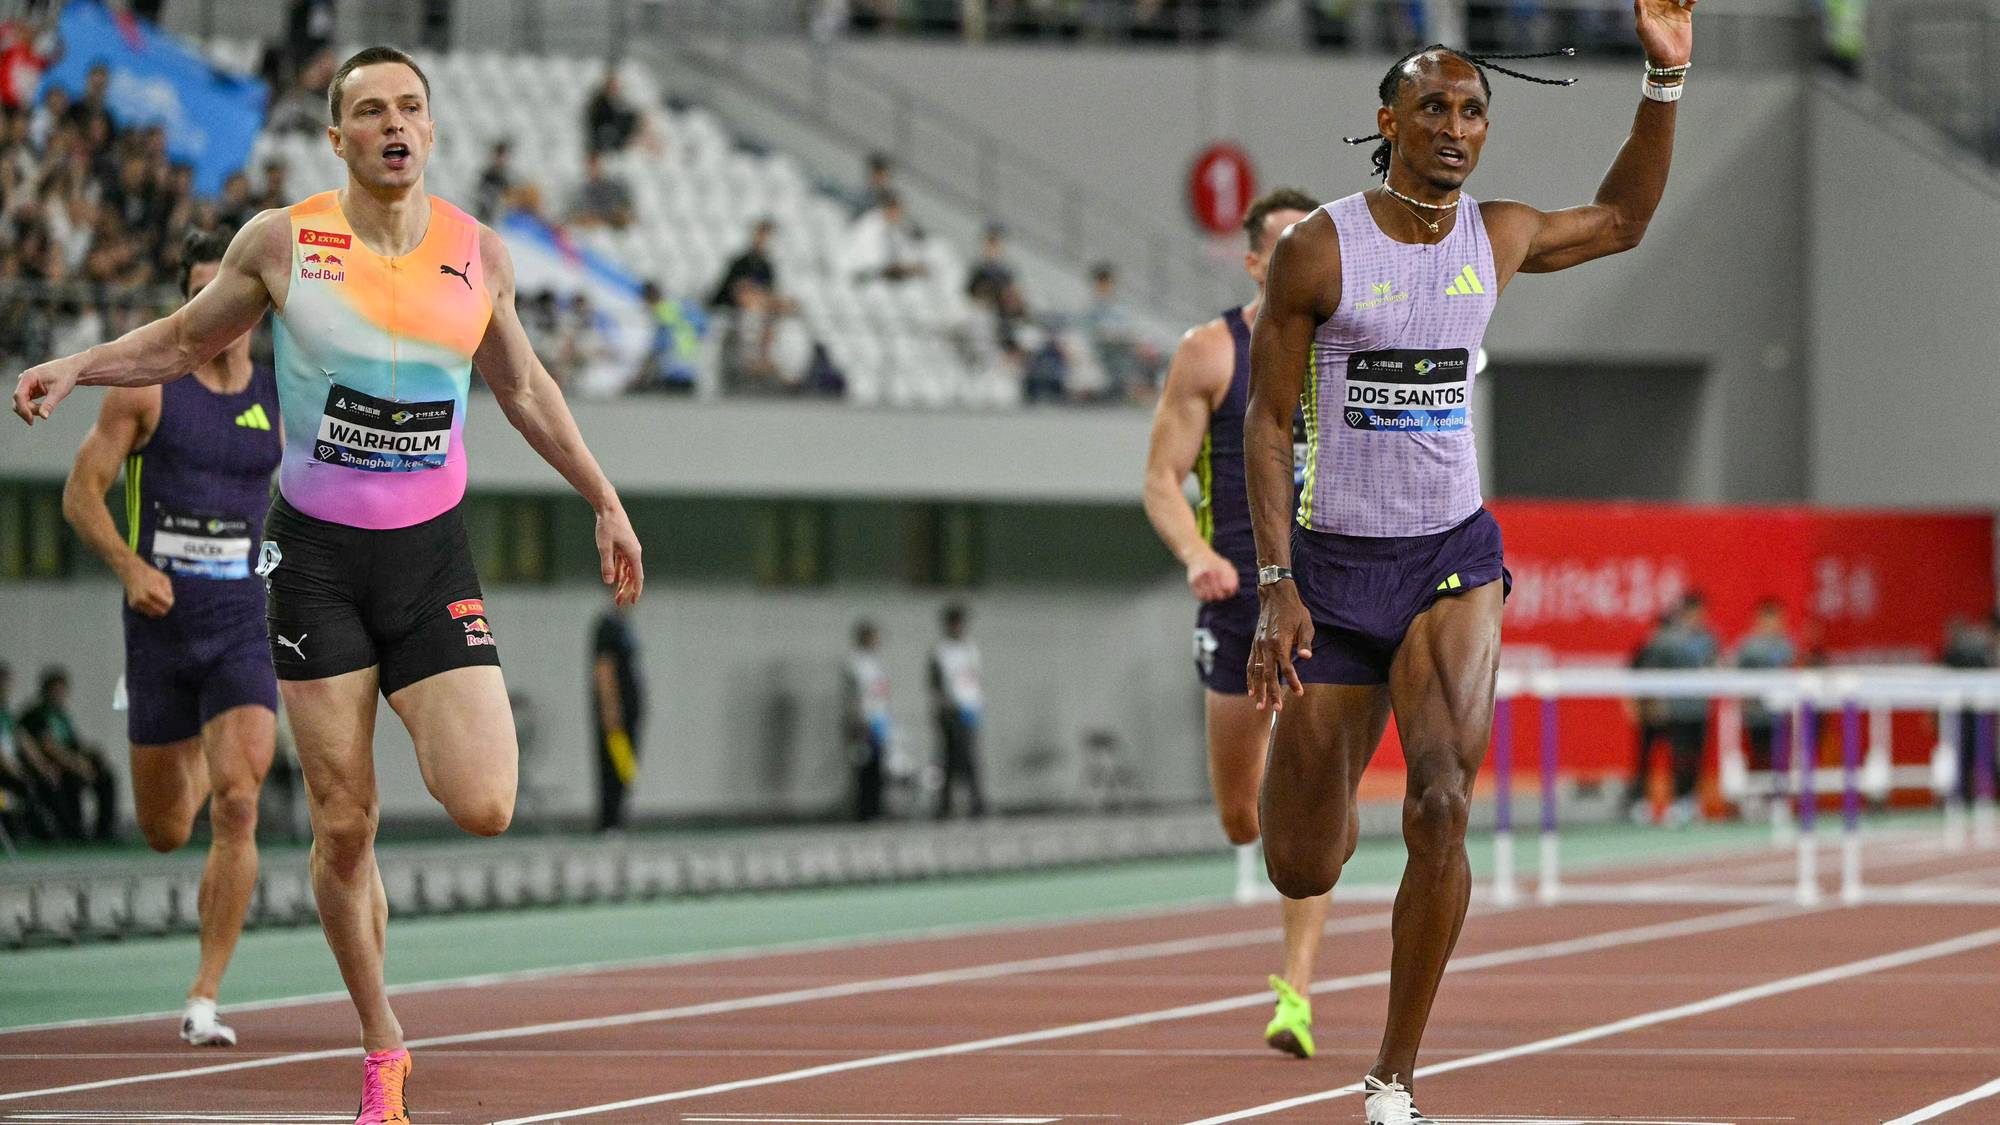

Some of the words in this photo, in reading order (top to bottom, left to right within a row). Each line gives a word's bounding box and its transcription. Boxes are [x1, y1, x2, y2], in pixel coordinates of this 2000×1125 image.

[318, 235, 346, 245] EXTRA
[301, 268, 322, 279] Red
[323, 270, 344, 281] Bull
[1348, 386, 1389, 404] DOS
[1394, 387, 1464, 405] SANTOS
[1369, 415, 1424, 428] Shanghai
[329, 422, 440, 452] WARHOLM
[340, 452, 394, 469] Shanghai
